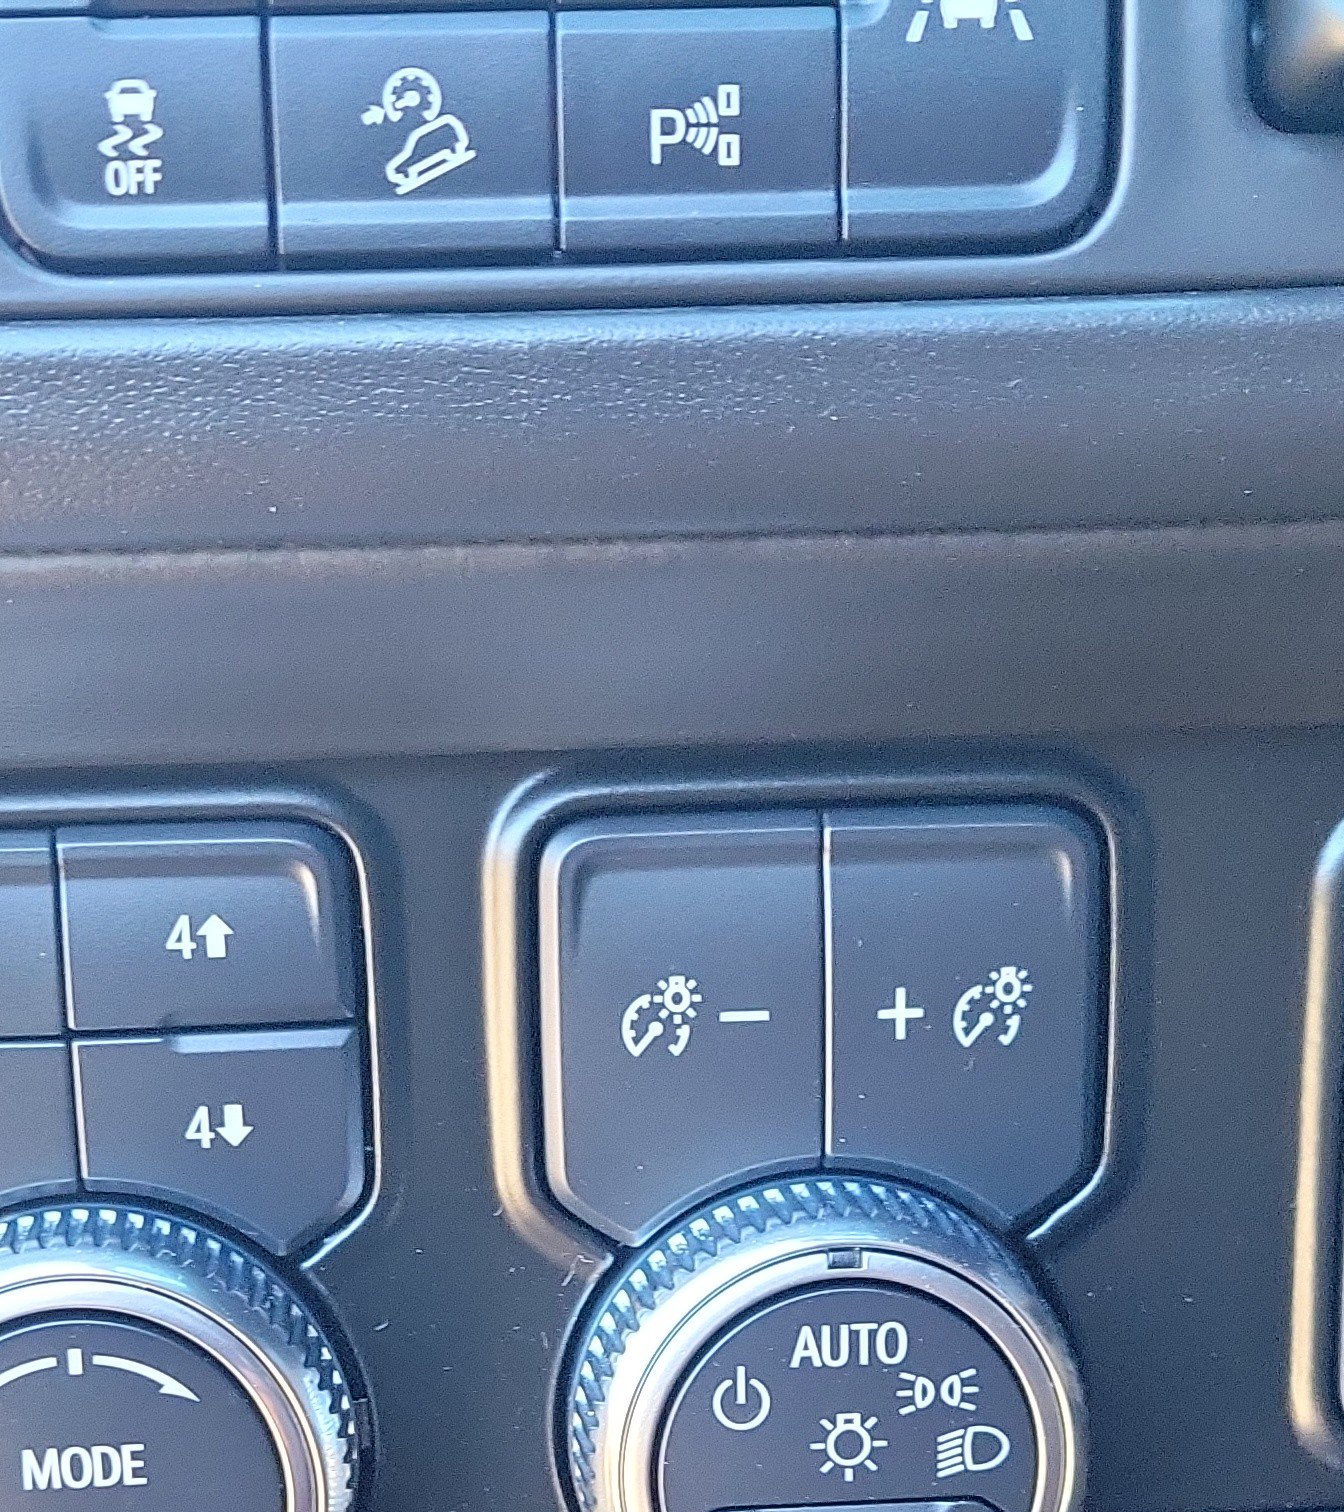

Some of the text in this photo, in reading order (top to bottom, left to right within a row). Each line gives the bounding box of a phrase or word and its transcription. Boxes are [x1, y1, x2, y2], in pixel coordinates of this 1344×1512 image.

[104, 158, 163, 196] OFF
[789, 1320, 909, 1369] AUTO
[20, 1443, 149, 1491] MODE
